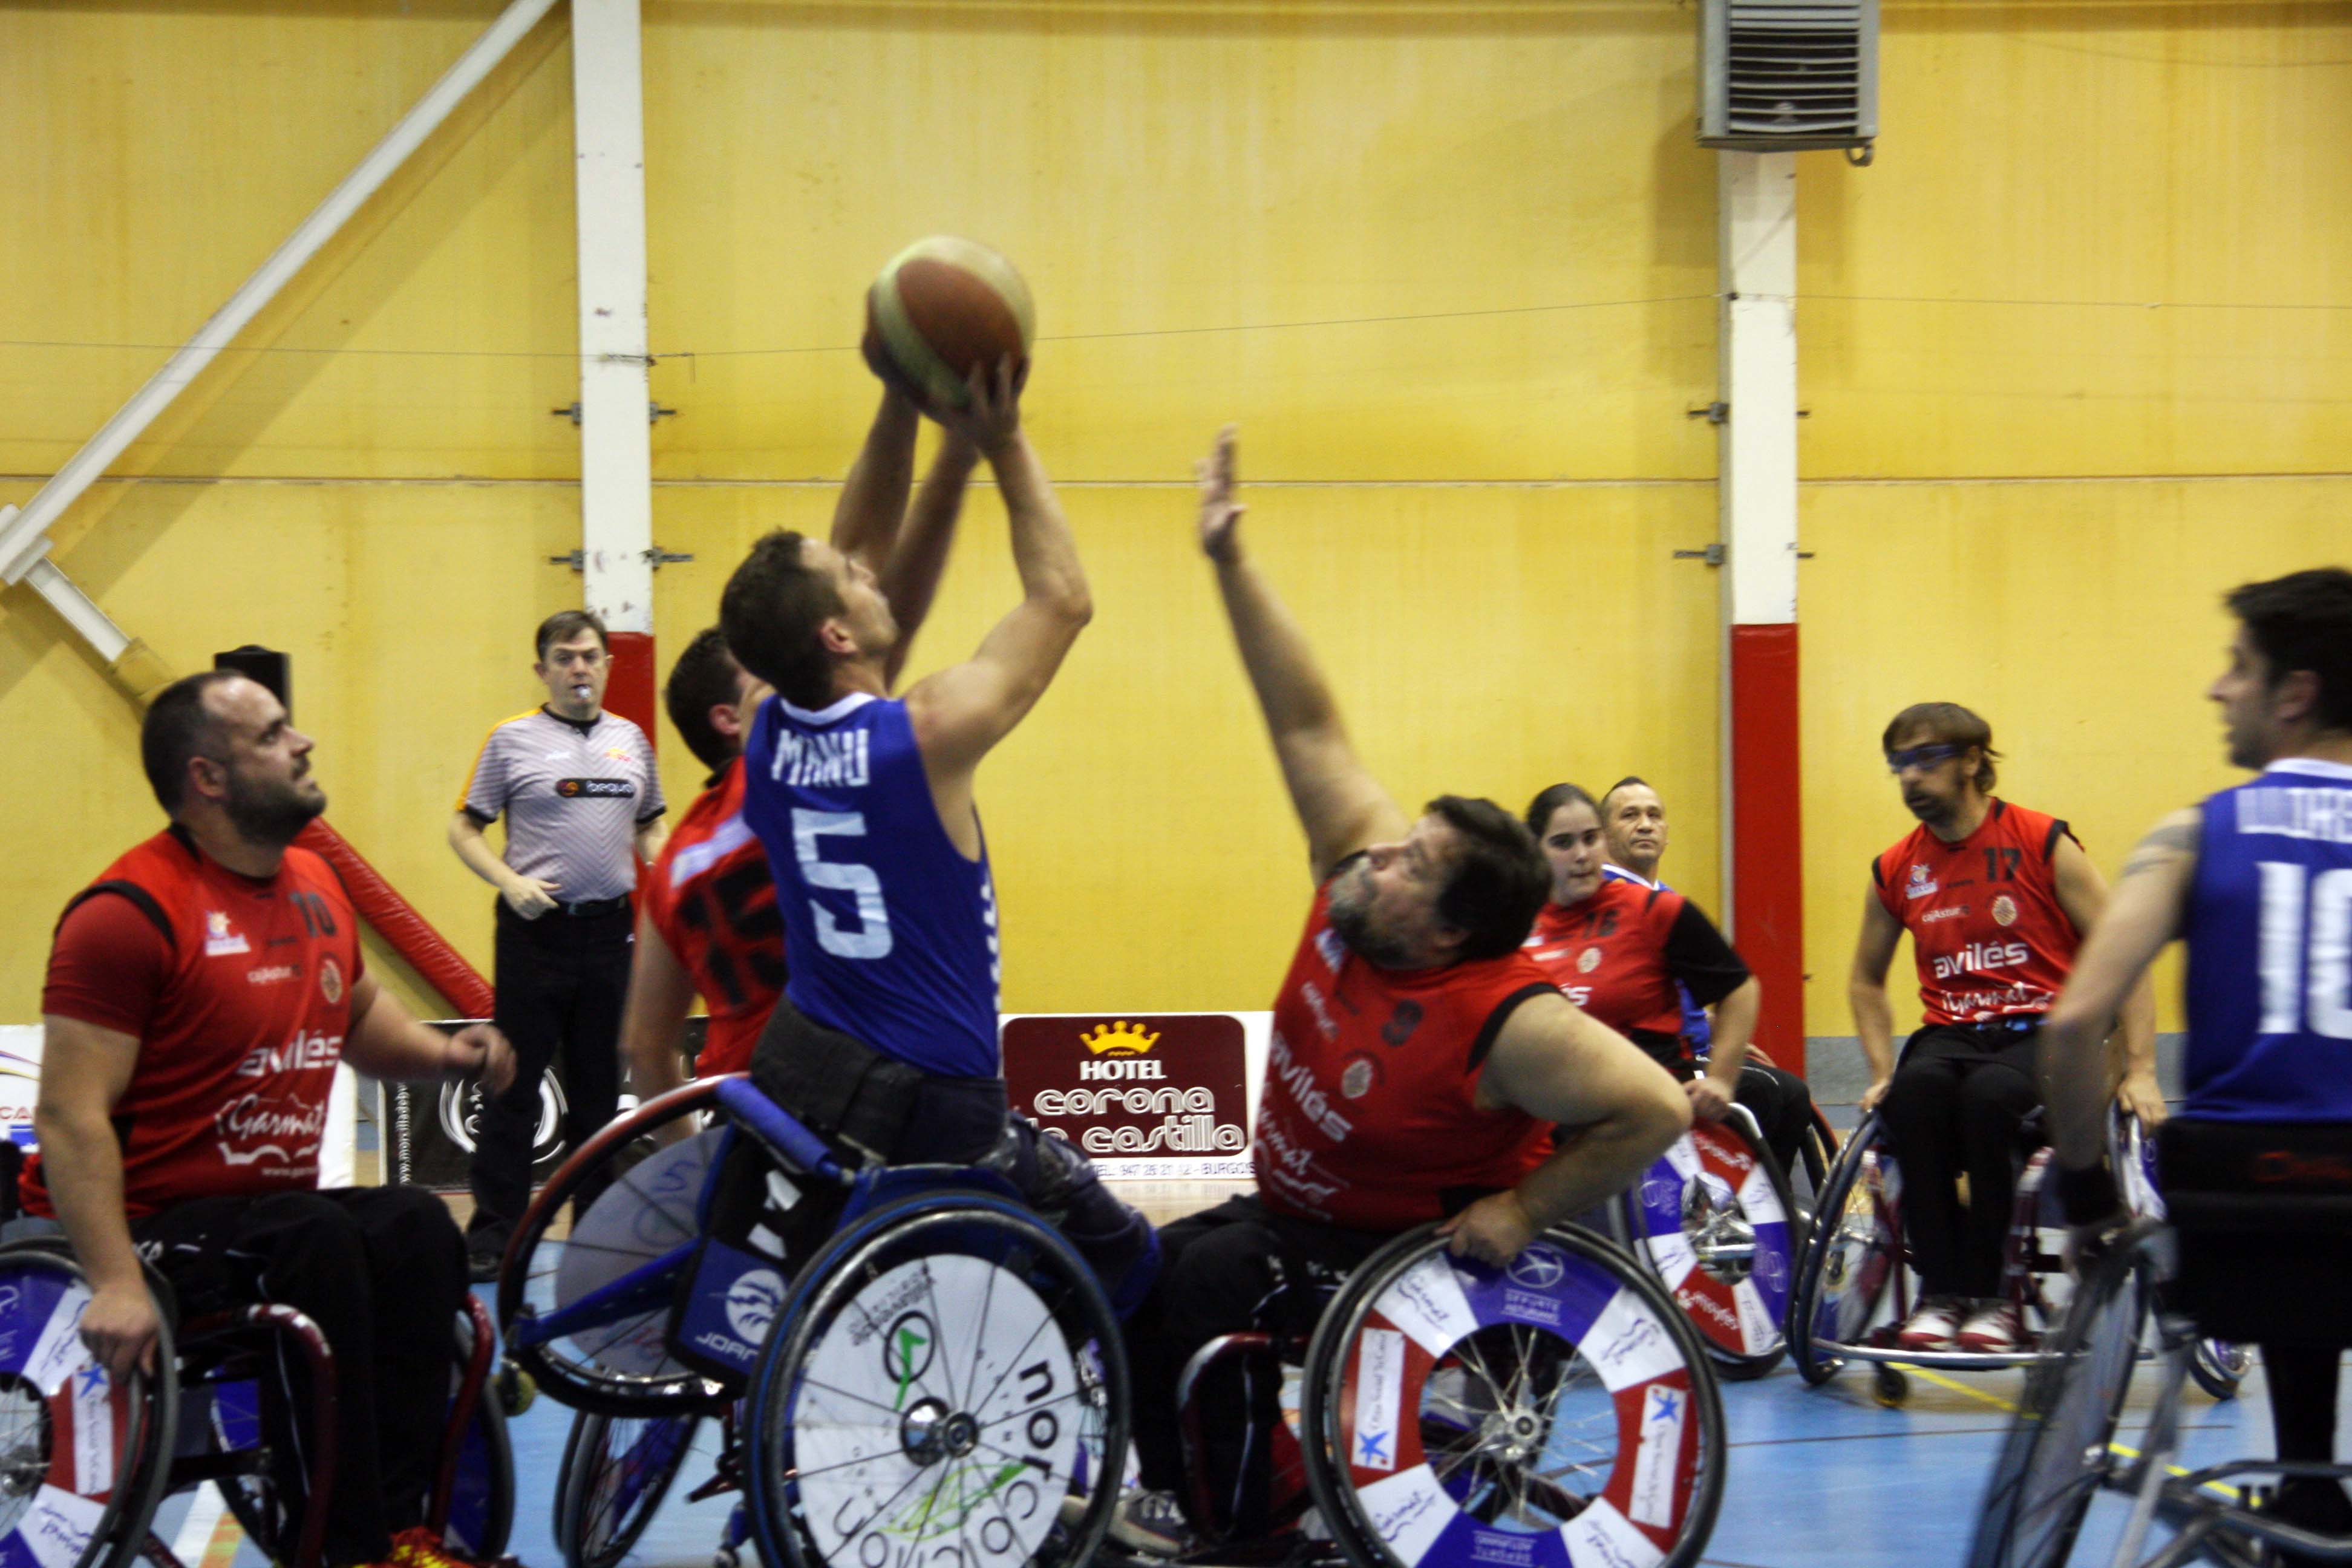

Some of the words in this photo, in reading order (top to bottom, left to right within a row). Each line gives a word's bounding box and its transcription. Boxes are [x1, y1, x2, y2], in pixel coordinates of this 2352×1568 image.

[771, 729, 869, 786] MANU
[1984, 847, 2020, 882] 17
[791, 808, 893, 959] 5
[1933, 941, 2029, 978] avilés
[1079, 1059, 1168, 1081] HOTEL
[1033, 1086, 1215, 1116] corona
[1082, 1115, 1246, 1153] castilla
